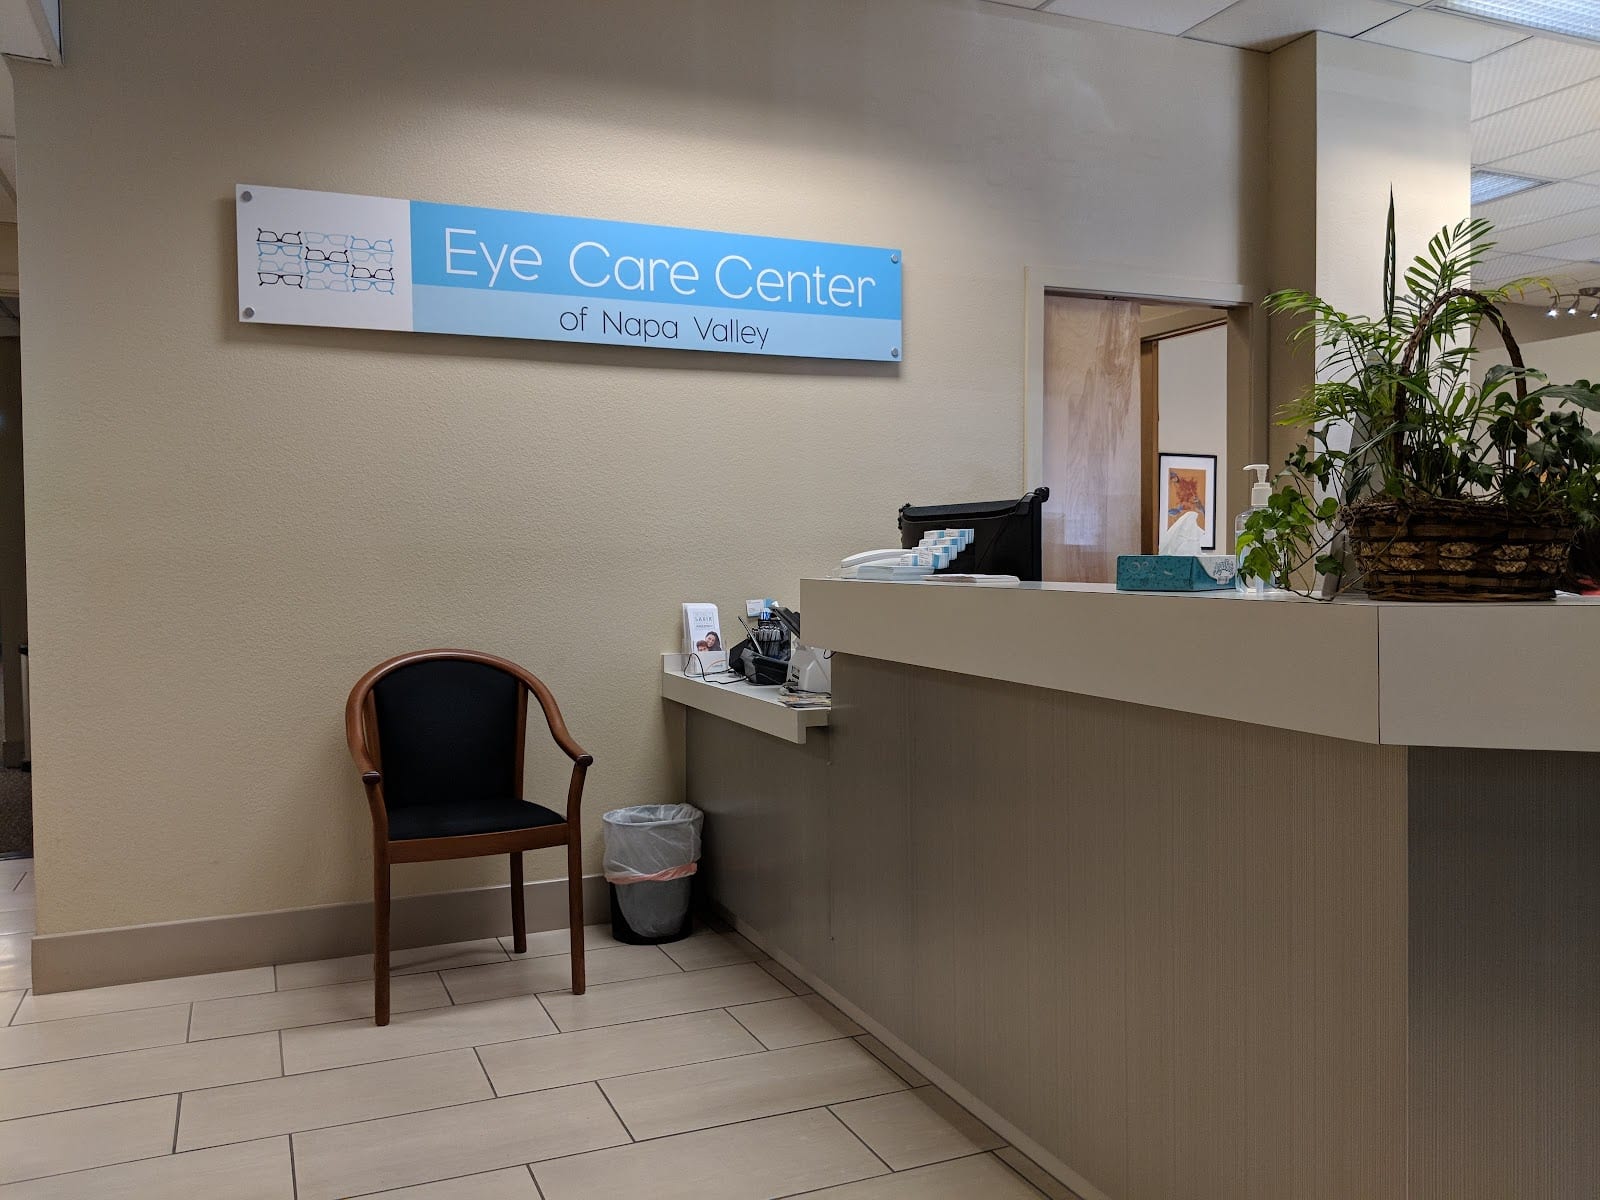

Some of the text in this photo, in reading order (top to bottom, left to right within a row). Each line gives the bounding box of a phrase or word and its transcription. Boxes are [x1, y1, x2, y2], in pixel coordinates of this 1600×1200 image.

[445, 227, 876, 308] Eye Care Center
[559, 306, 770, 350] of Napa Valley
